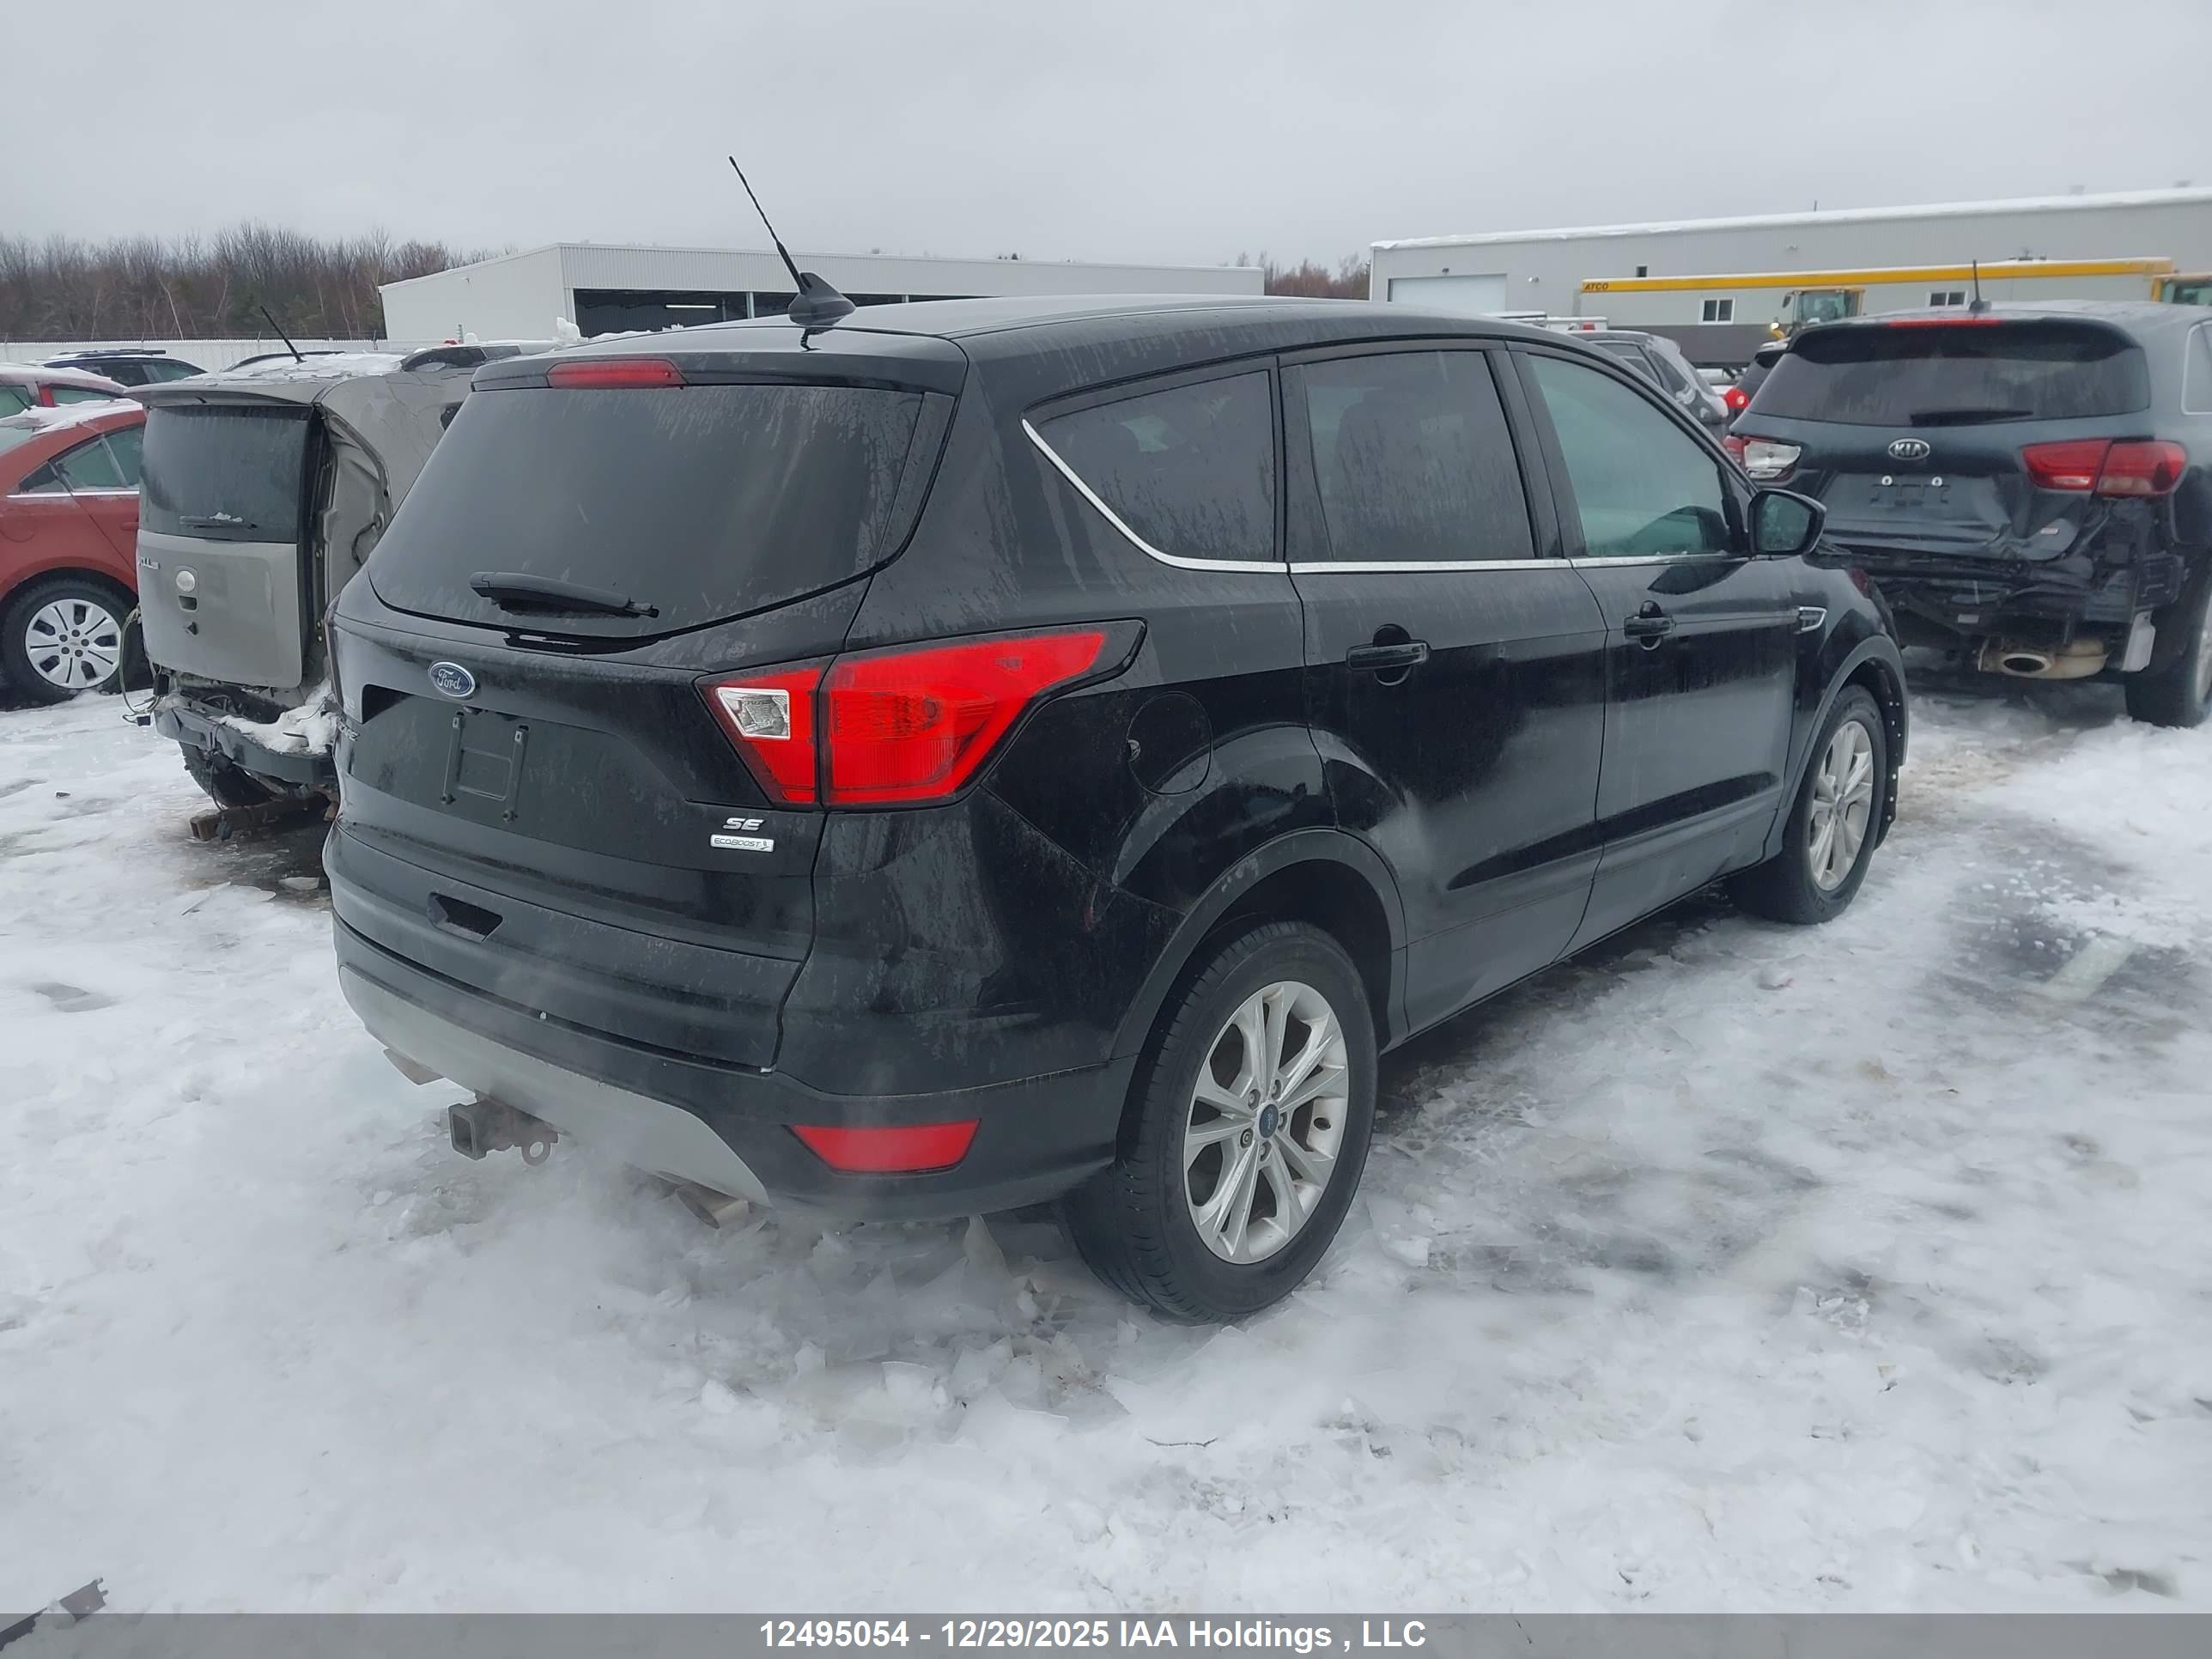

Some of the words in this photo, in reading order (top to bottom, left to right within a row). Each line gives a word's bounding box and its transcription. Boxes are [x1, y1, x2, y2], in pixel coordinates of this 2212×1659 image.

[1584, 282, 1609, 290] ATCO
[1895, 443, 1923, 456] KIA
[437, 668, 462, 690] Ford
[722, 817, 764, 831] SE
[714, 837, 762, 848] ECOBOOST
